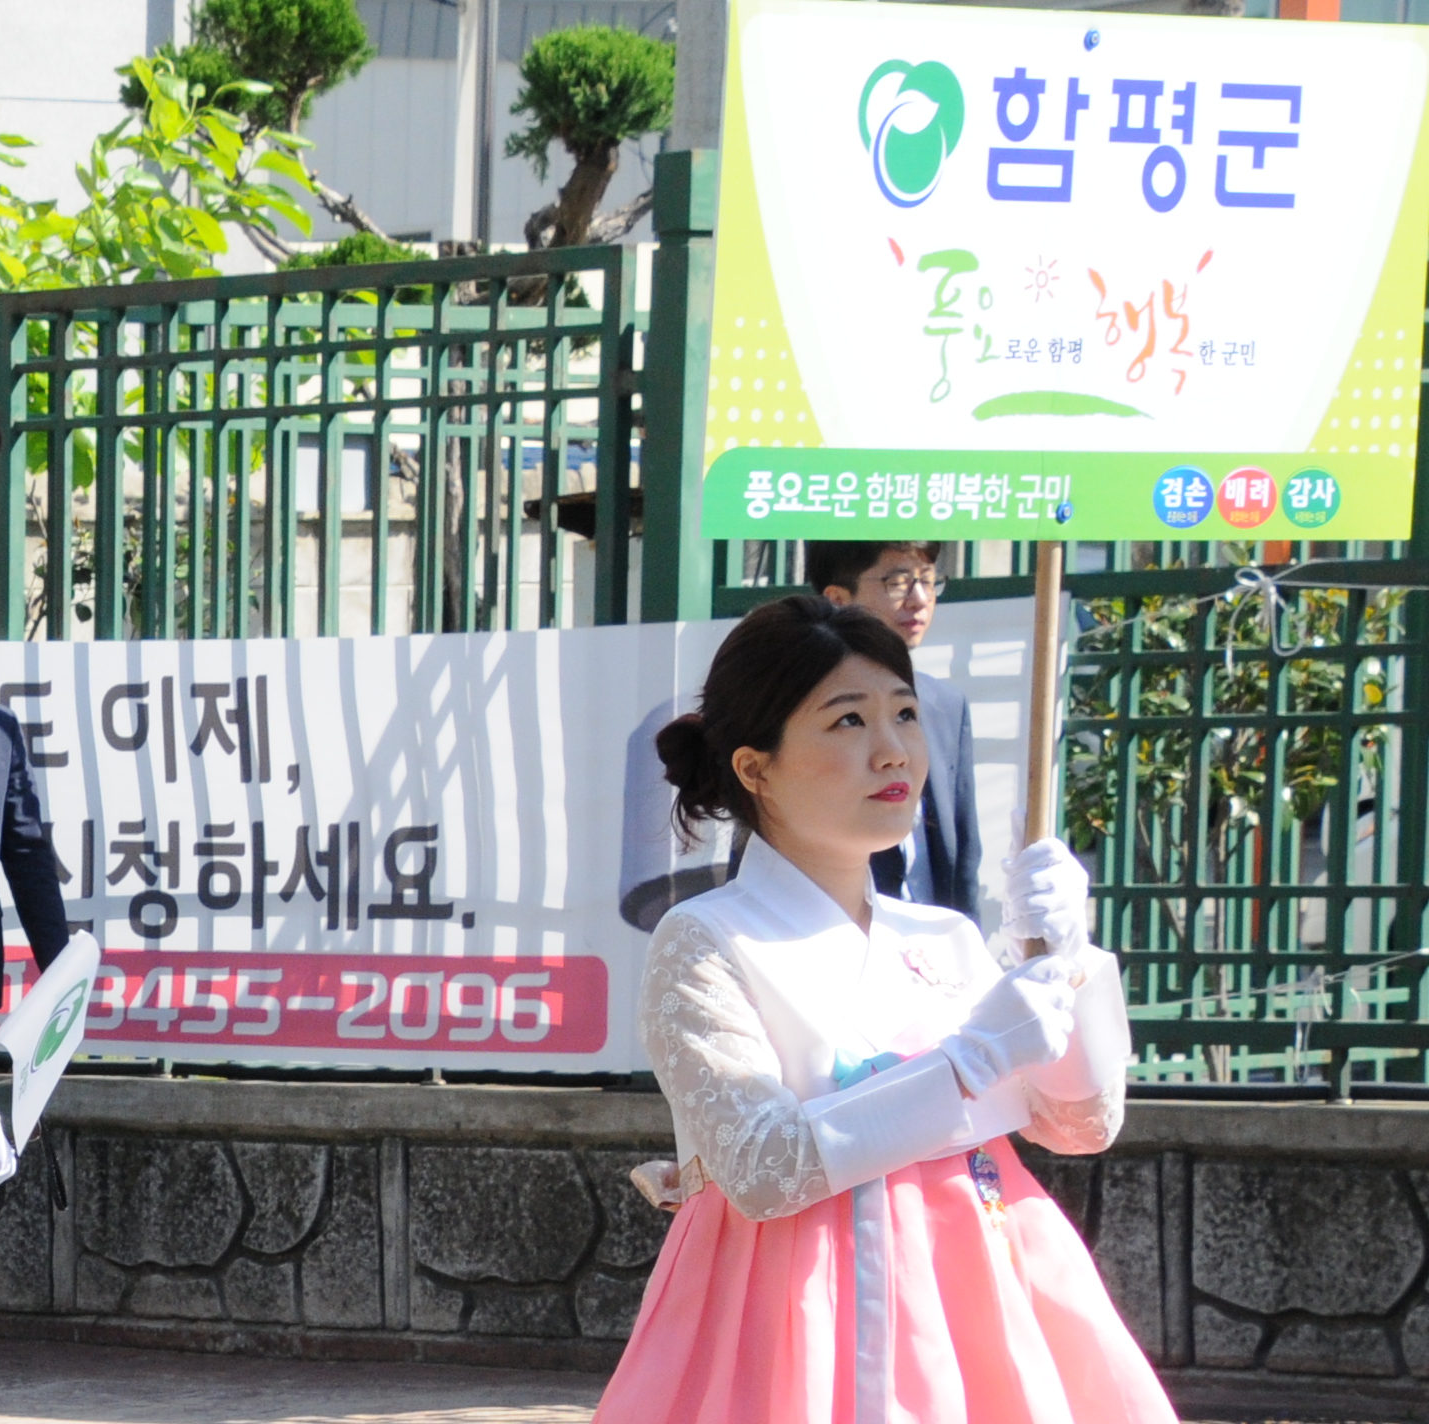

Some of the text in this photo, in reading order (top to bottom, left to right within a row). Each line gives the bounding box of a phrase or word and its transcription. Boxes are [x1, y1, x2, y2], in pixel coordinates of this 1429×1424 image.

[986, 66, 1302, 213] 함평군
[1221, 340, 1256, 367] 군민
[743, 470, 1073, 520] 풍요로운 함평 행복한 군민
[1160, 477, 1207, 508] 겸손
[1224, 477, 1271, 508] 배려
[1288, 477, 1336, 508] 감사
[101, 675, 300, 793] 이제,
